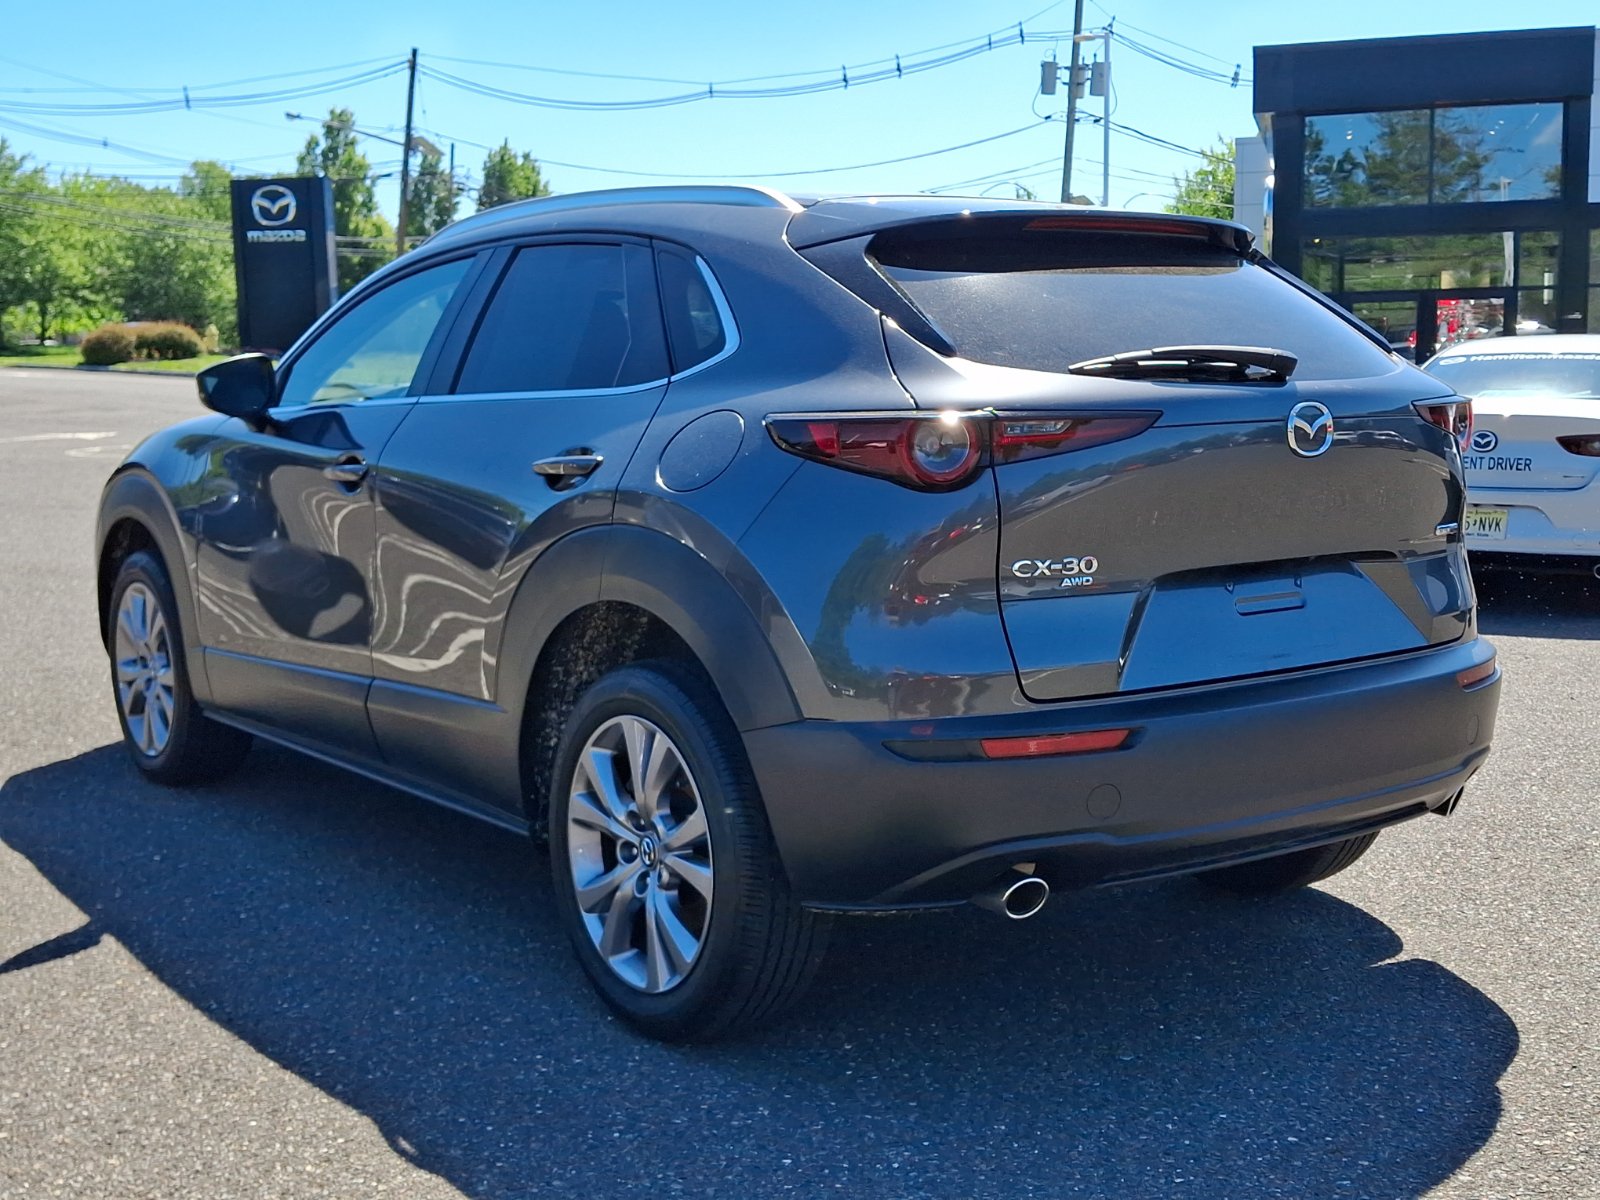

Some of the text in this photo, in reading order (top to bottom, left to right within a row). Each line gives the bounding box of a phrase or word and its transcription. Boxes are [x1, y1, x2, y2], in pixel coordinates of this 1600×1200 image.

[247, 229, 306, 242] mazda
[1488, 456, 1532, 471] DRIVER
[1012, 555, 1099, 578] CX-30
[1061, 576, 1094, 587] AWD
